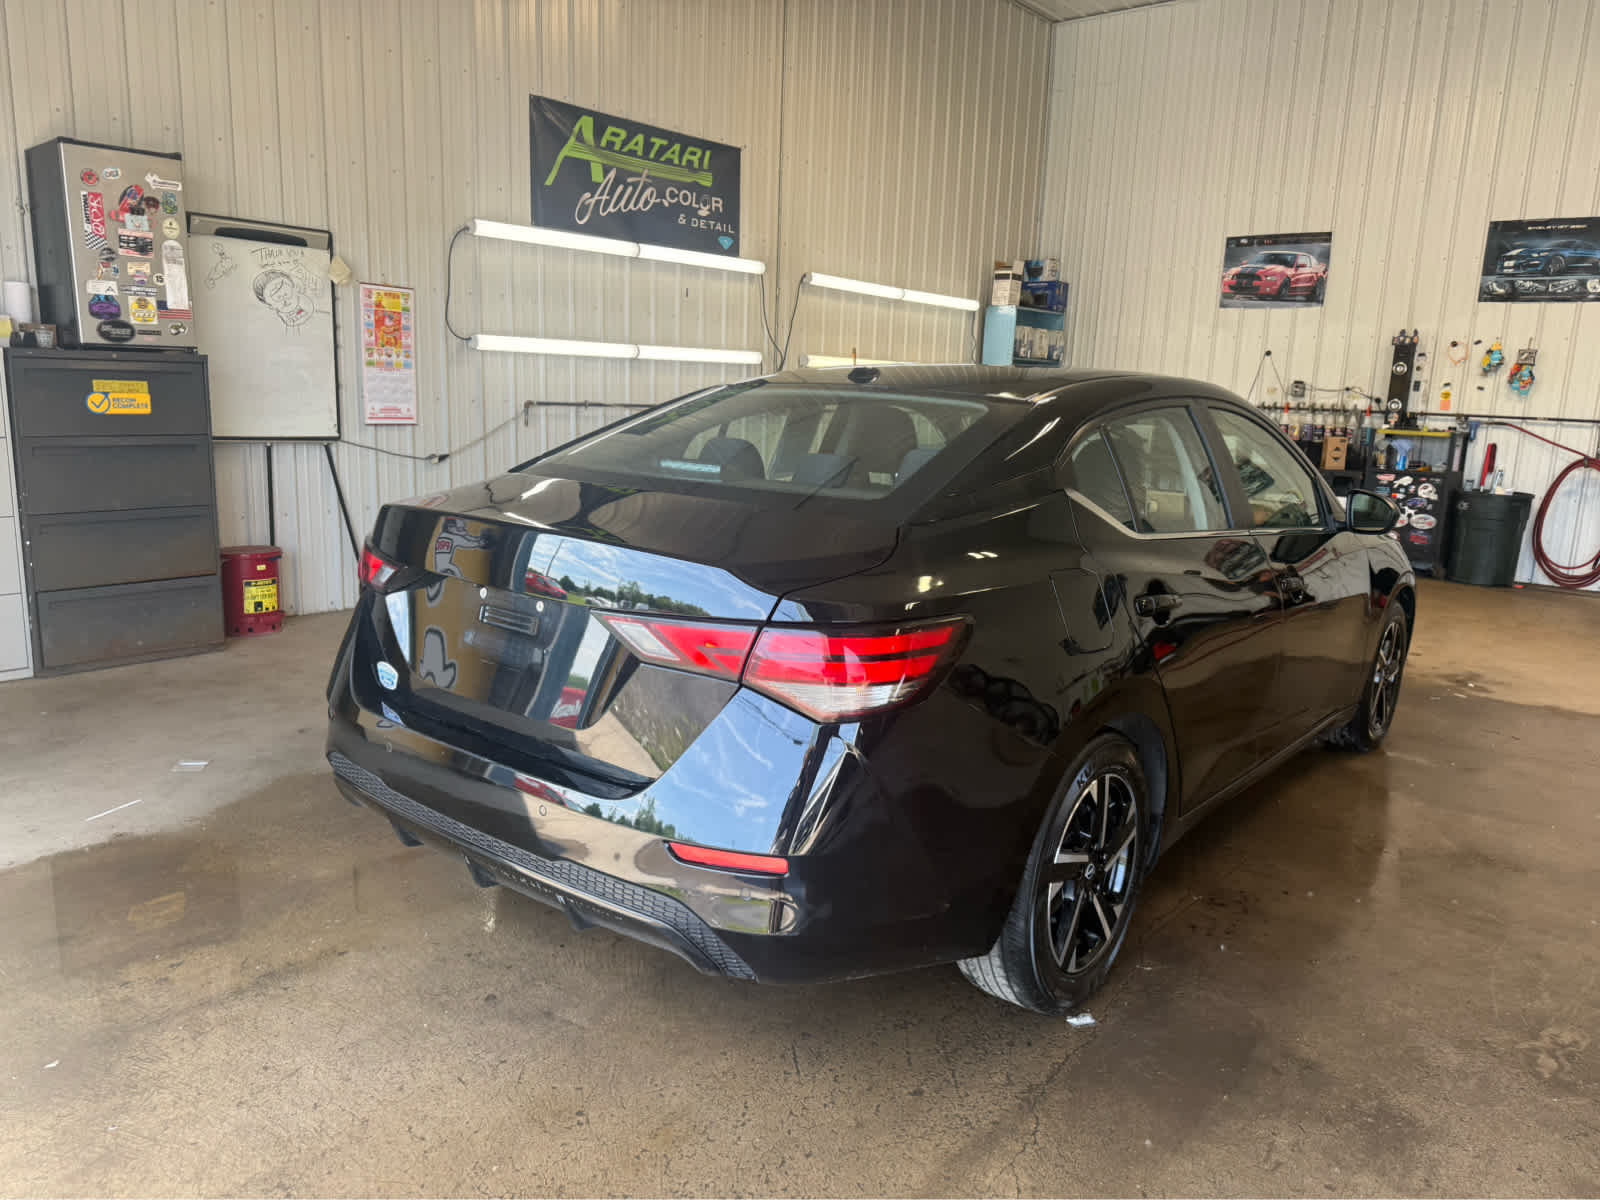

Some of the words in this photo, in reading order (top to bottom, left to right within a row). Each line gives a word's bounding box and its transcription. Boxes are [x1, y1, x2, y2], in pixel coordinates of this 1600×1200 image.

[544, 115, 712, 187] ARATARI
[575, 167, 658, 224] Auto
[678, 213, 687, 225] &
[690, 217, 736, 234] DETAIL
